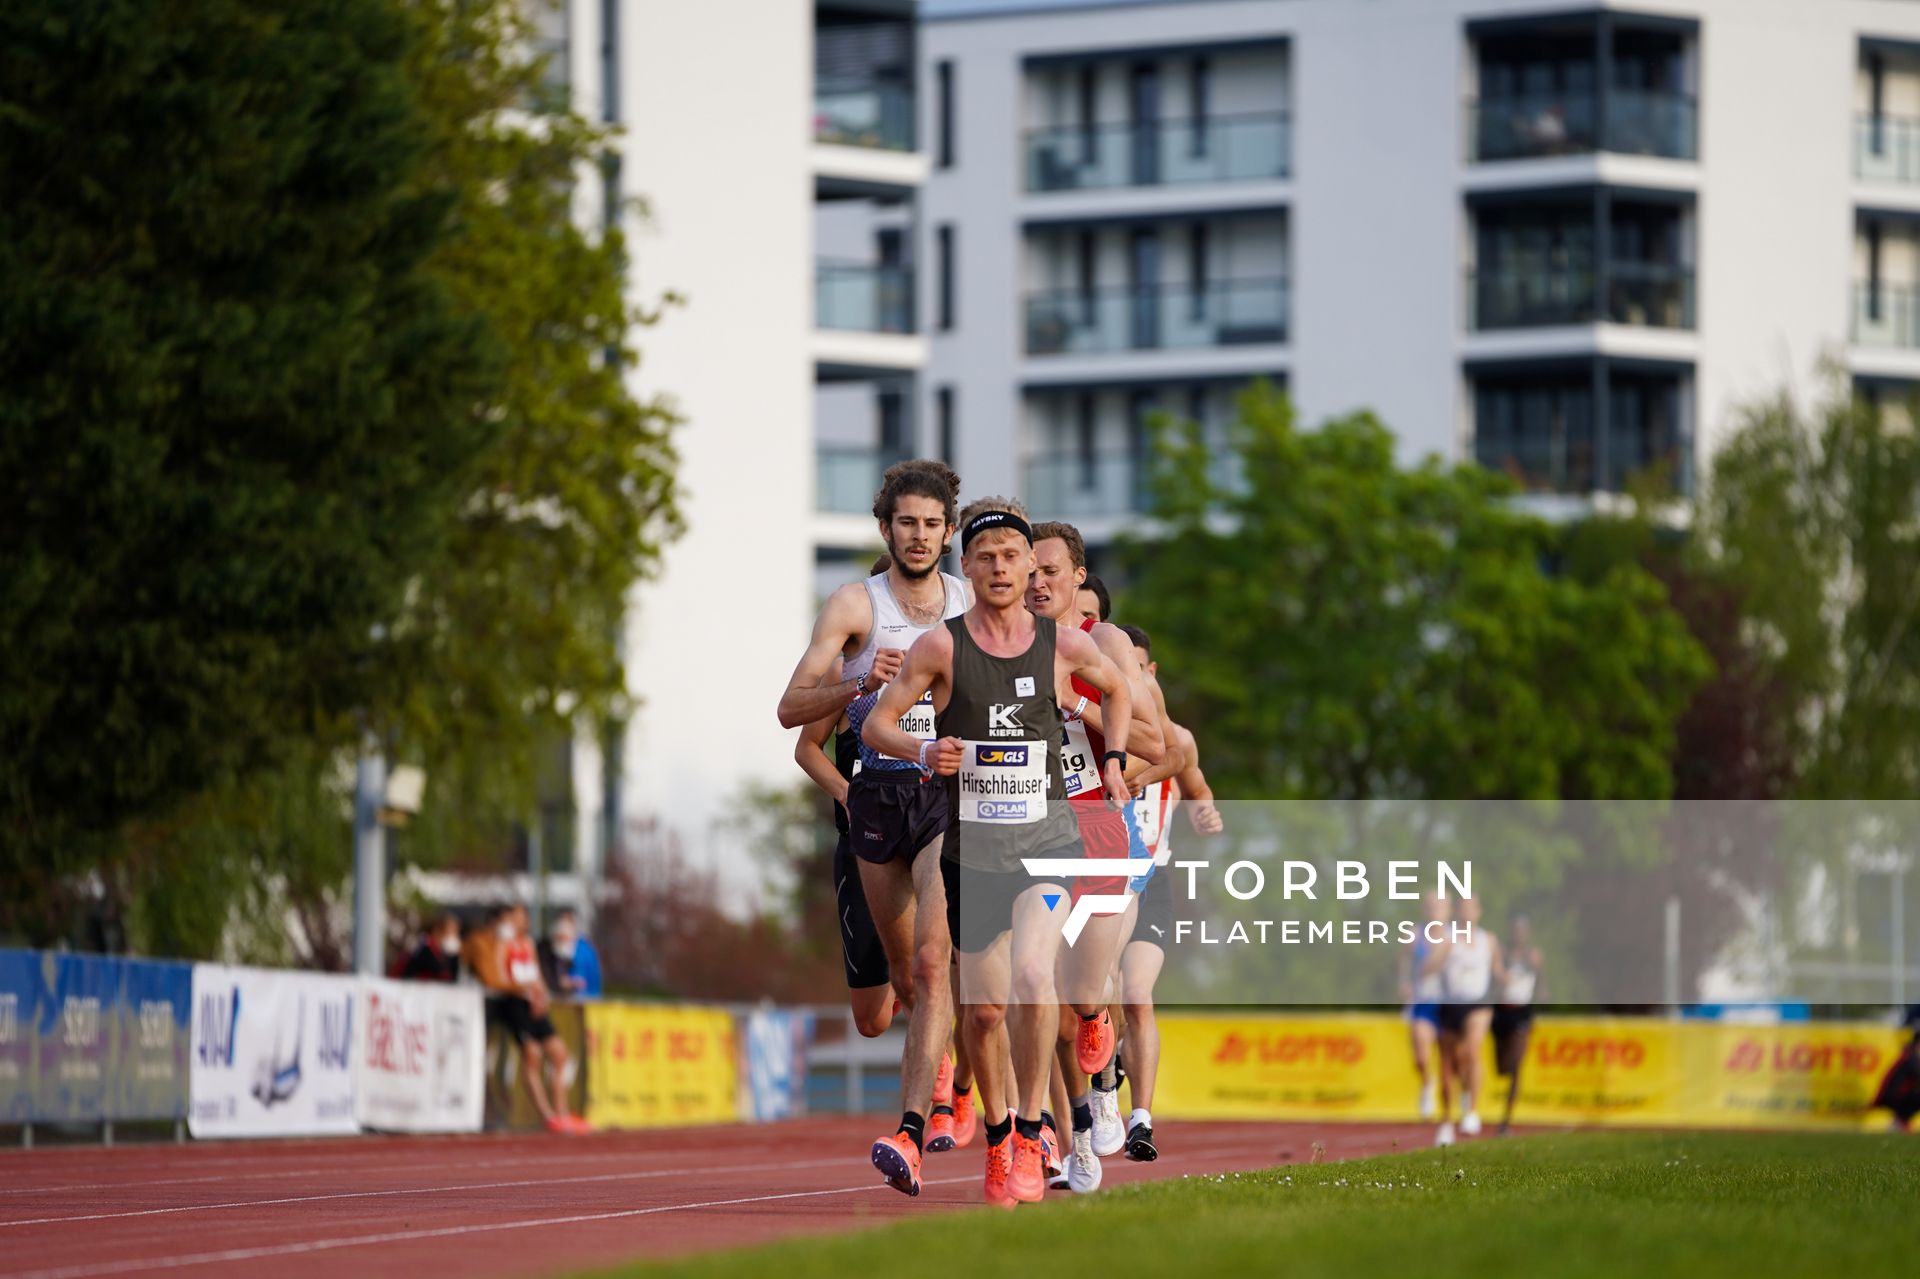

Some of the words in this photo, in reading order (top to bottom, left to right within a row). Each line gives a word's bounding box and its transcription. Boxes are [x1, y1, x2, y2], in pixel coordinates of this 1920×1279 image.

[898, 712, 931, 733] ndane
[988, 728, 1025, 737] KIEFER
[1003, 751, 1025, 763] GLS
[1060, 751, 1087, 773] ig
[962, 771, 1043, 795] Hirschhäuser
[1065, 777, 1081, 789] AN
[997, 804, 1026, 814] PLAN
[1259, 1034, 1366, 1066] LOTTO
[1537, 1036, 1646, 1068] LOTTO
[1773, 1043, 1882, 1075] LOTTO
